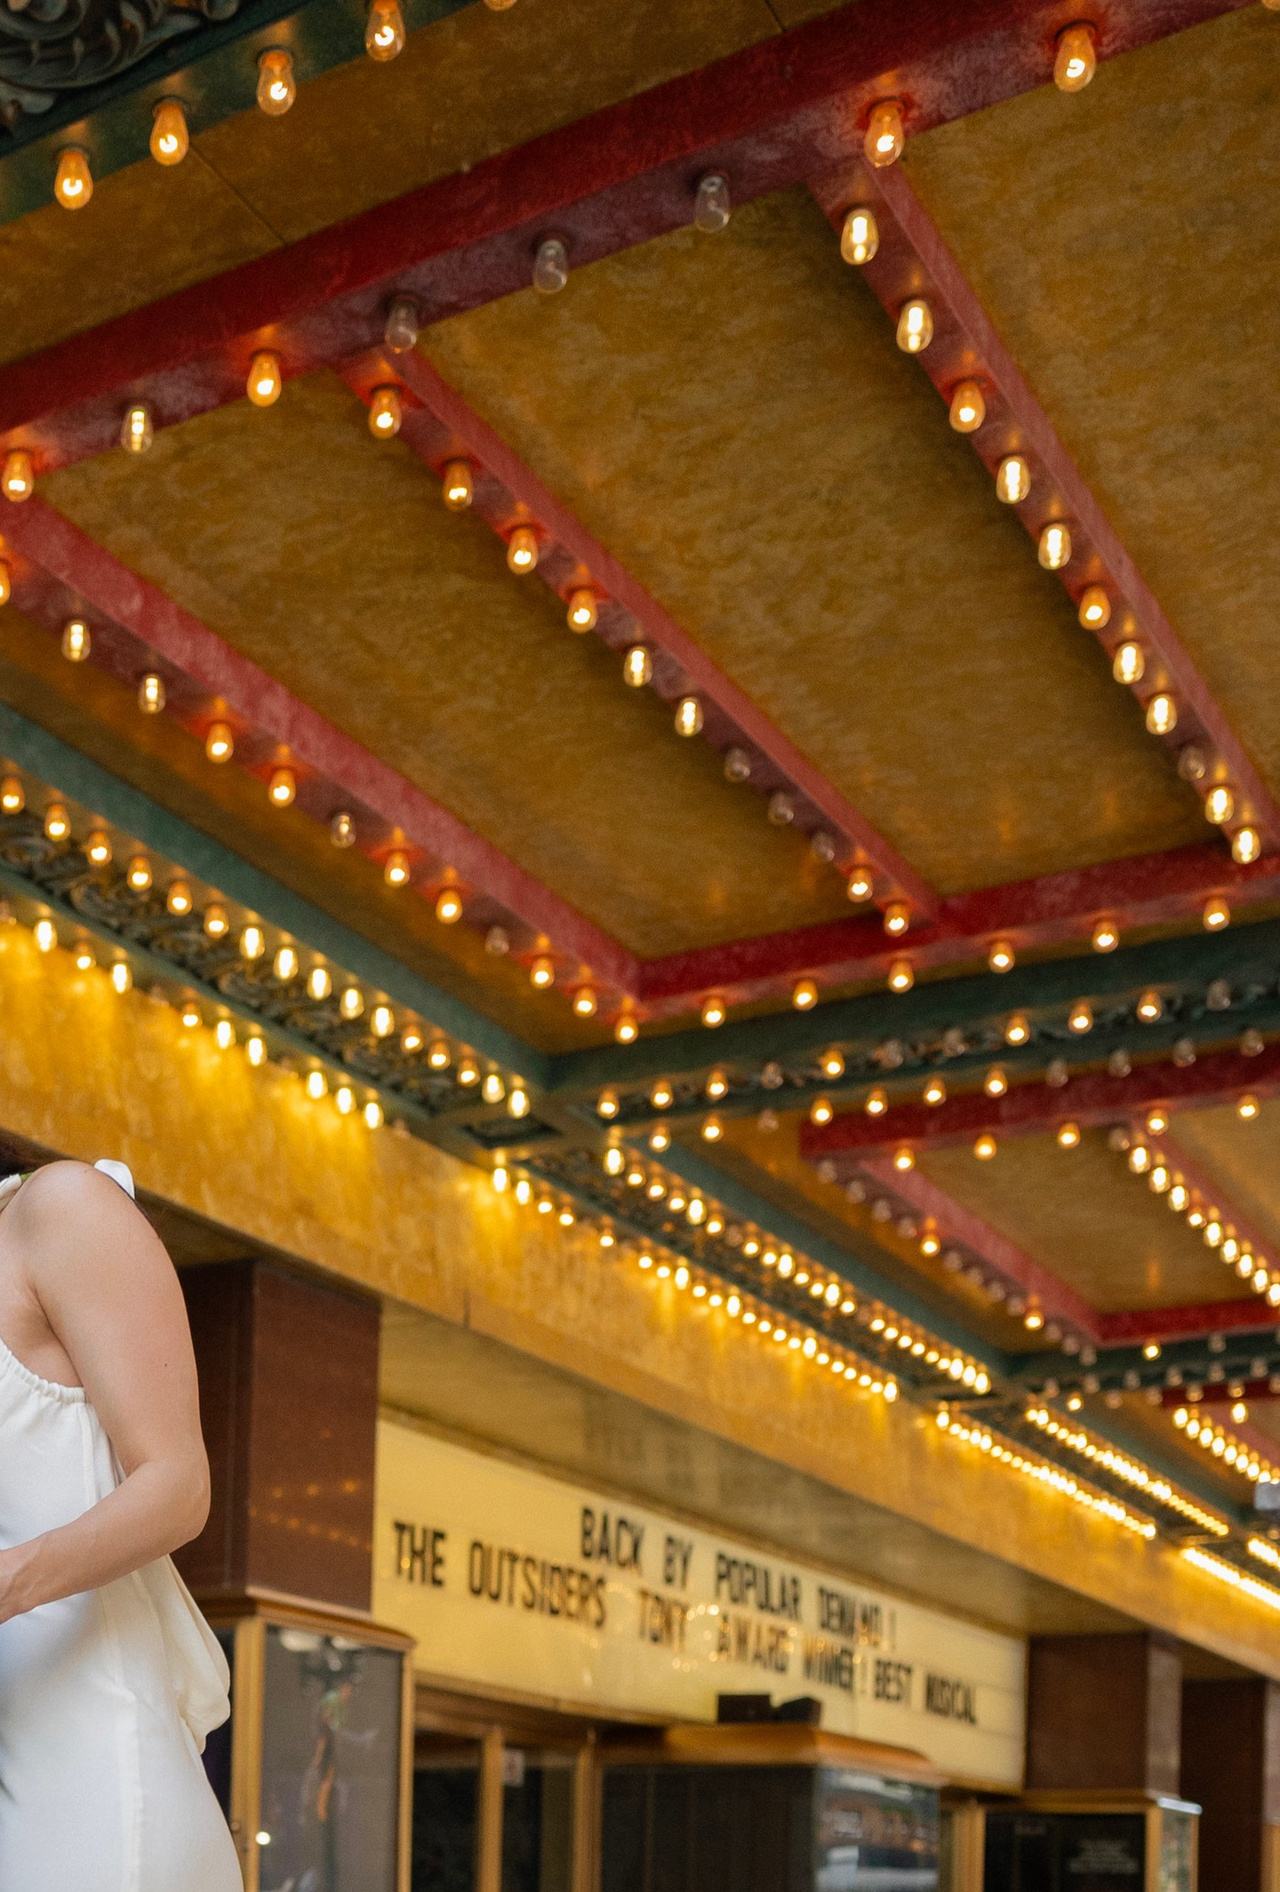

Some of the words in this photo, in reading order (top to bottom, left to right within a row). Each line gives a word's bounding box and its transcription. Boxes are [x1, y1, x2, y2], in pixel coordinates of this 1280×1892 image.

[394, 1519, 446, 1588] THE
[469, 1539, 607, 1630] OUTSIDERS
[637, 1588, 689, 1653] TONY
[874, 1657, 913, 1704] BEST
[925, 1671, 978, 1726] MUSICAL
[581, 1506, 645, 1574] BACK
[664, 1535, 694, 1591] BY
[716, 1551, 801, 1622] POPULAR
